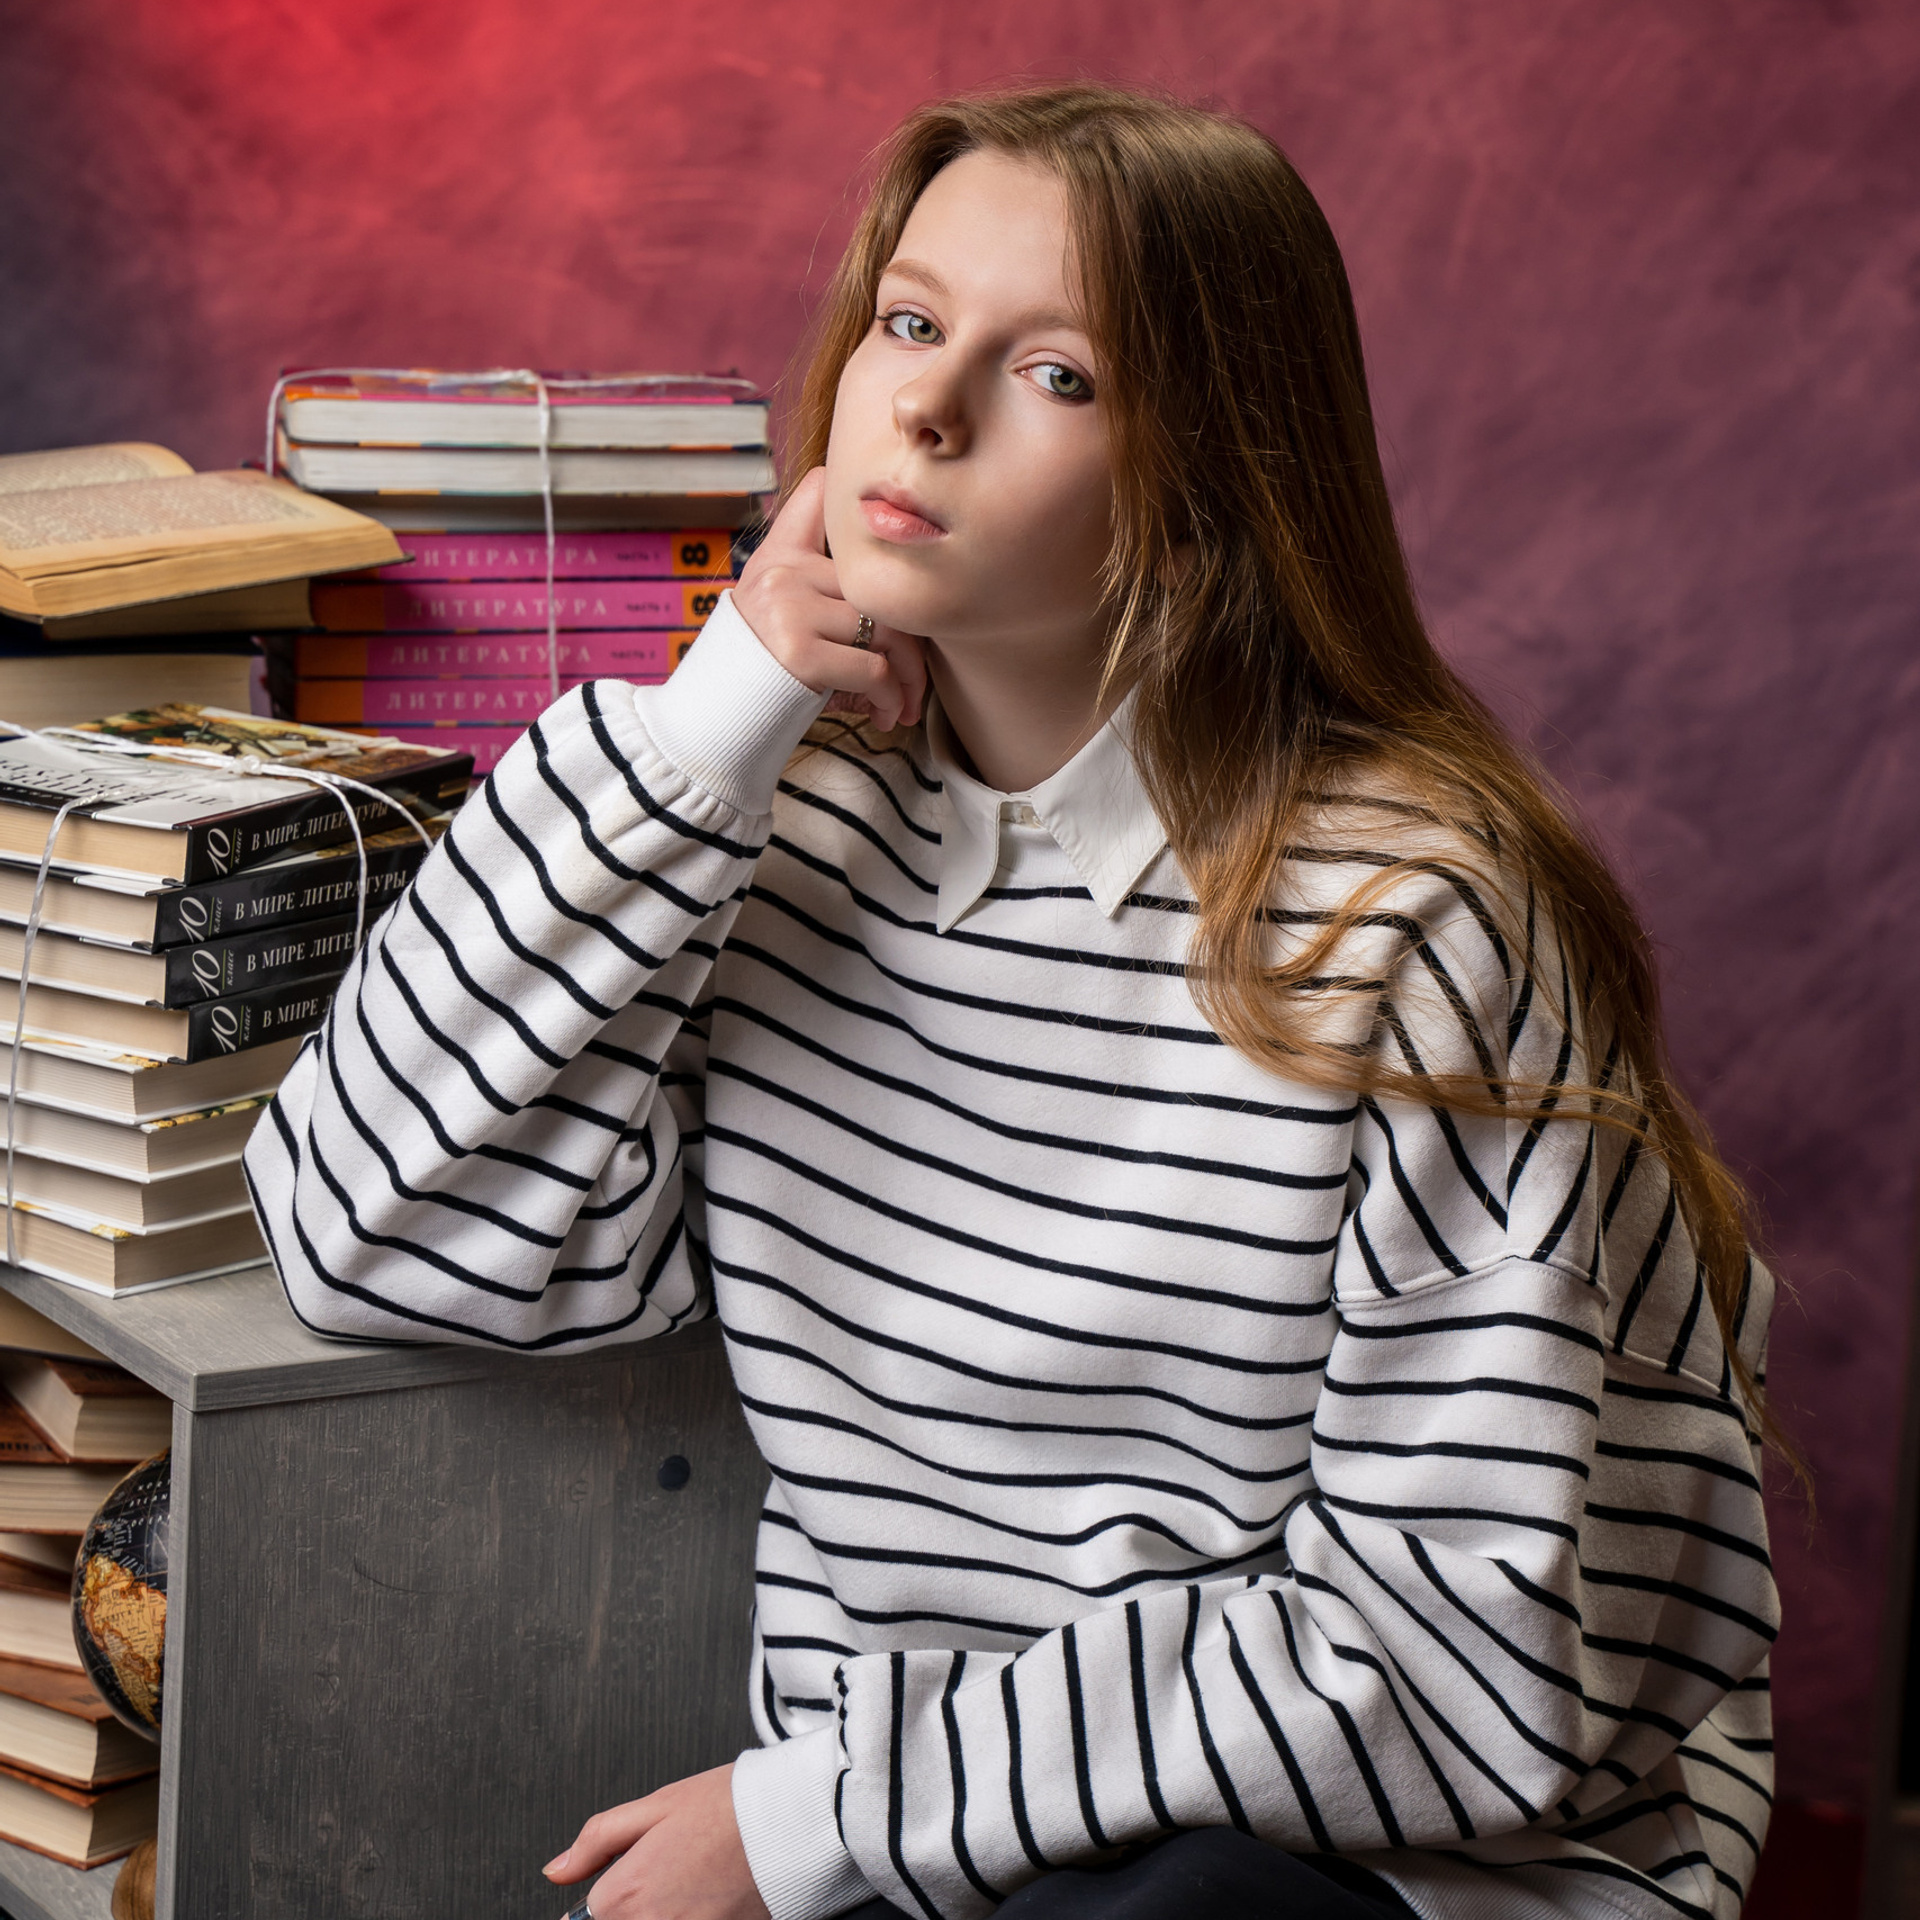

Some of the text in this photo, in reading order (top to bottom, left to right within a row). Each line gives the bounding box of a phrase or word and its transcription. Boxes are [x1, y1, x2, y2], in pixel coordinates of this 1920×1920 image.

[681, 543, 710, 567] 8
[409, 598, 607, 617] ЛИТЕРАТУРА
[391, 645, 591, 663] ЛИТЕРАТУРА
[207, 828, 231, 876] 10
[251, 833, 261, 852] В
[264, 822, 301, 848] МИРЕ
[179, 896, 208, 943] 10
[234, 902, 245, 921] В
[250, 892, 295, 918] МИРЕ
[246, 954, 256, 973] В
[262, 942, 306, 969] МИРЕ
[192, 950, 220, 998] 10
[262, 1010, 272, 1028] В
[277, 998, 319, 1024] МИРЕ
[211, 1005, 238, 1053] 10
